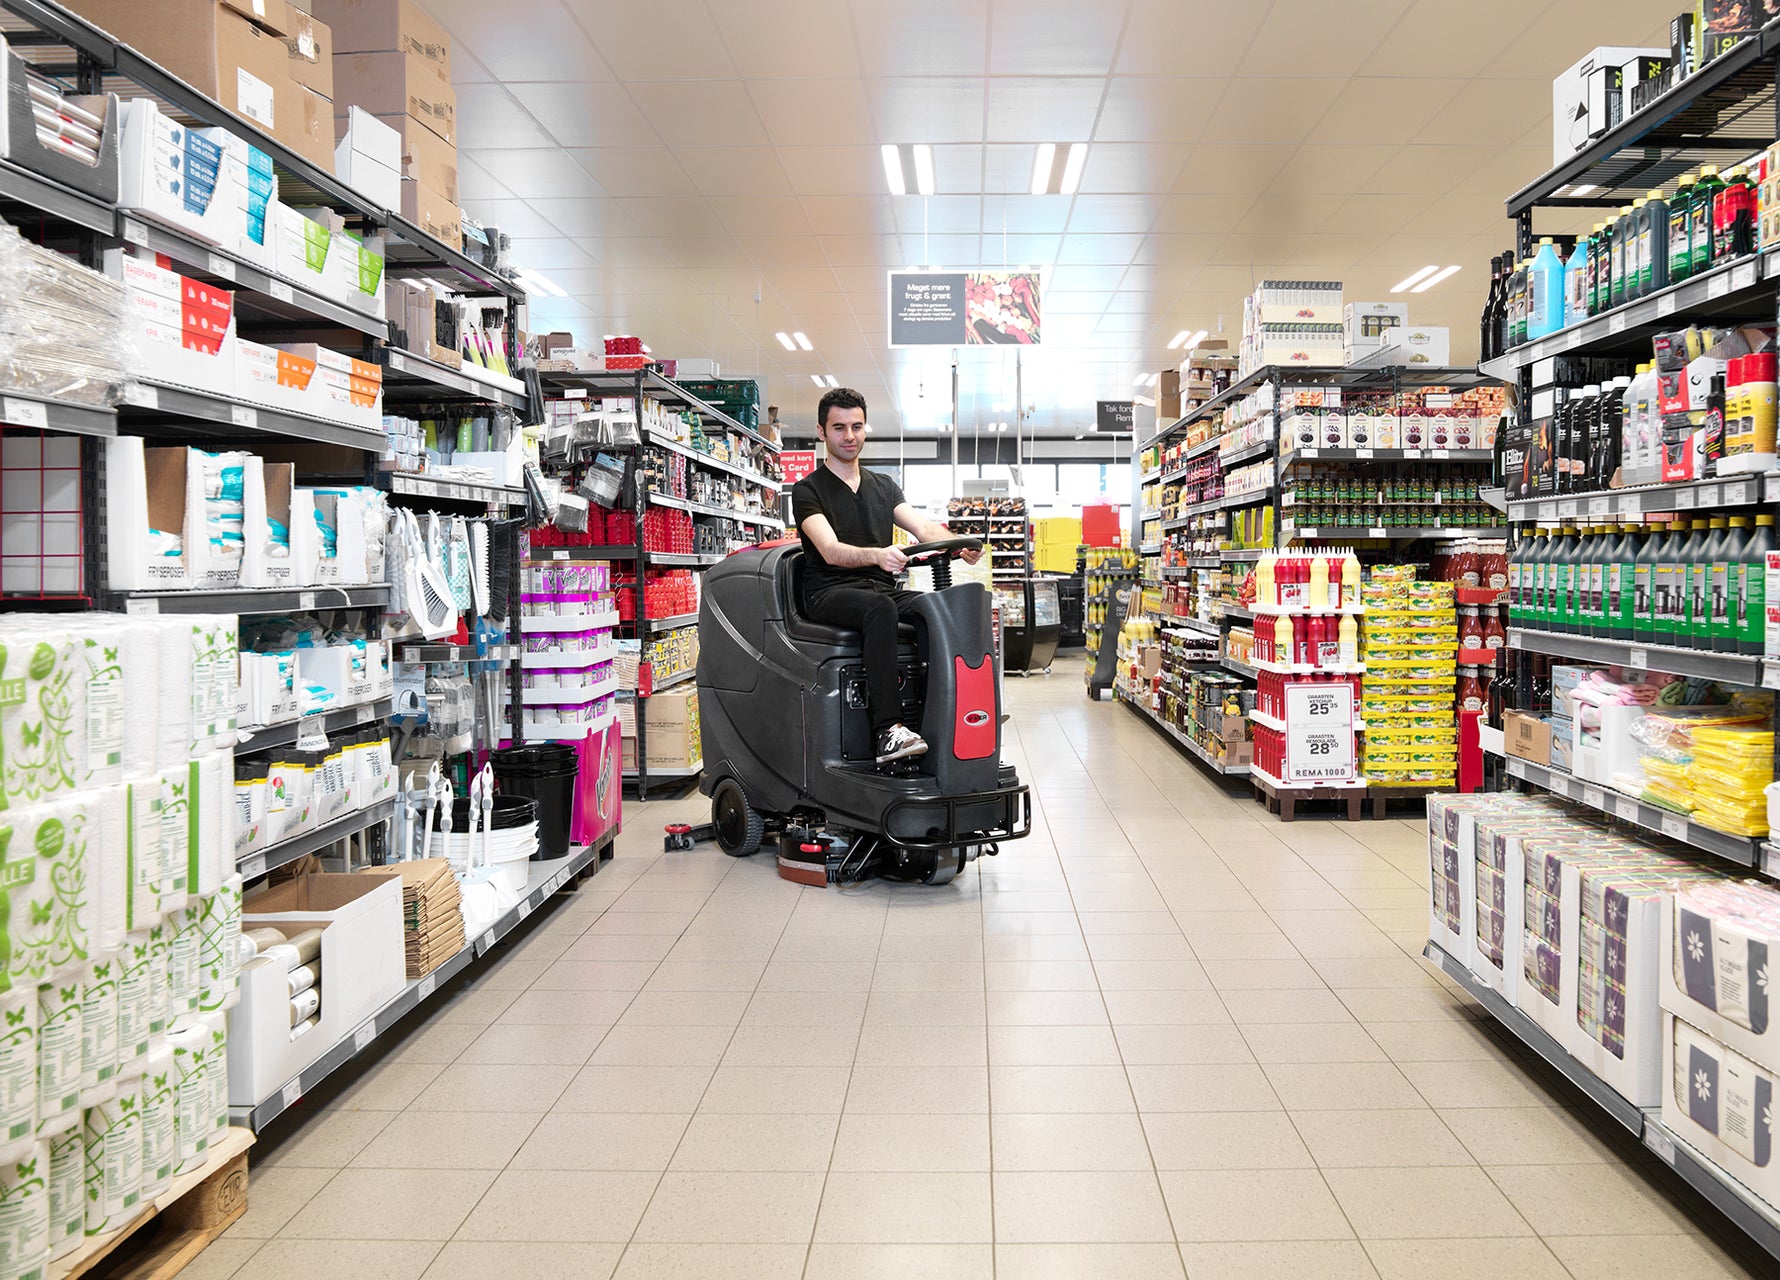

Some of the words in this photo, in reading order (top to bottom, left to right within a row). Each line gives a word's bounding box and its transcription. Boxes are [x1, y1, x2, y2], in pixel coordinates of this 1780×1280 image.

[905, 292, 922, 301] frugt
[1506, 449, 1524, 465] Blitz
[1310, 703, 1329, 715] 25
[1310, 743, 1330, 754] 28
